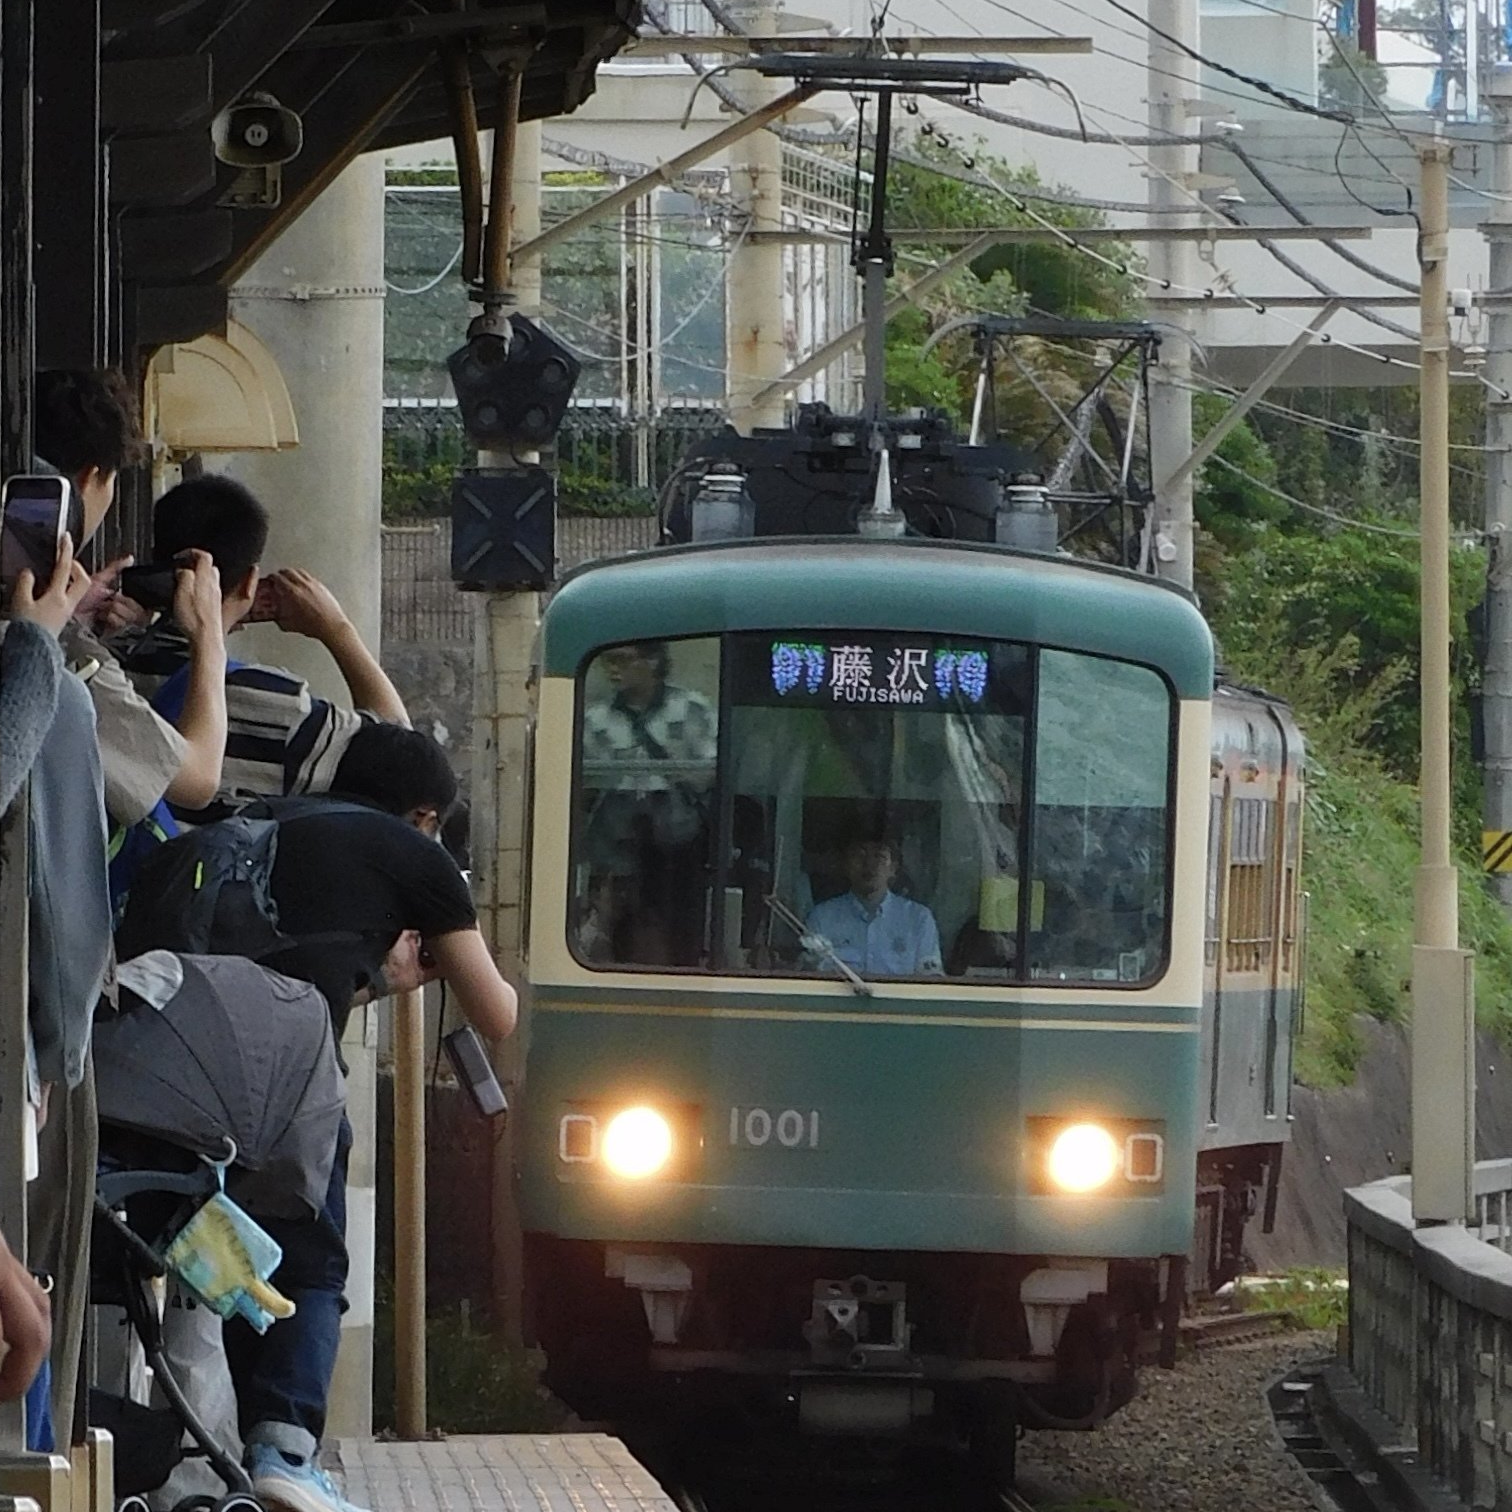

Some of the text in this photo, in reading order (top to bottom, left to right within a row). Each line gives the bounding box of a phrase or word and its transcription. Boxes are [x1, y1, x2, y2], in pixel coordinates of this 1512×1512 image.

[829, 645, 929, 690] 藤沢
[833, 687, 924, 703] FUJISAWA
[729, 1106, 819, 1148] 1001
